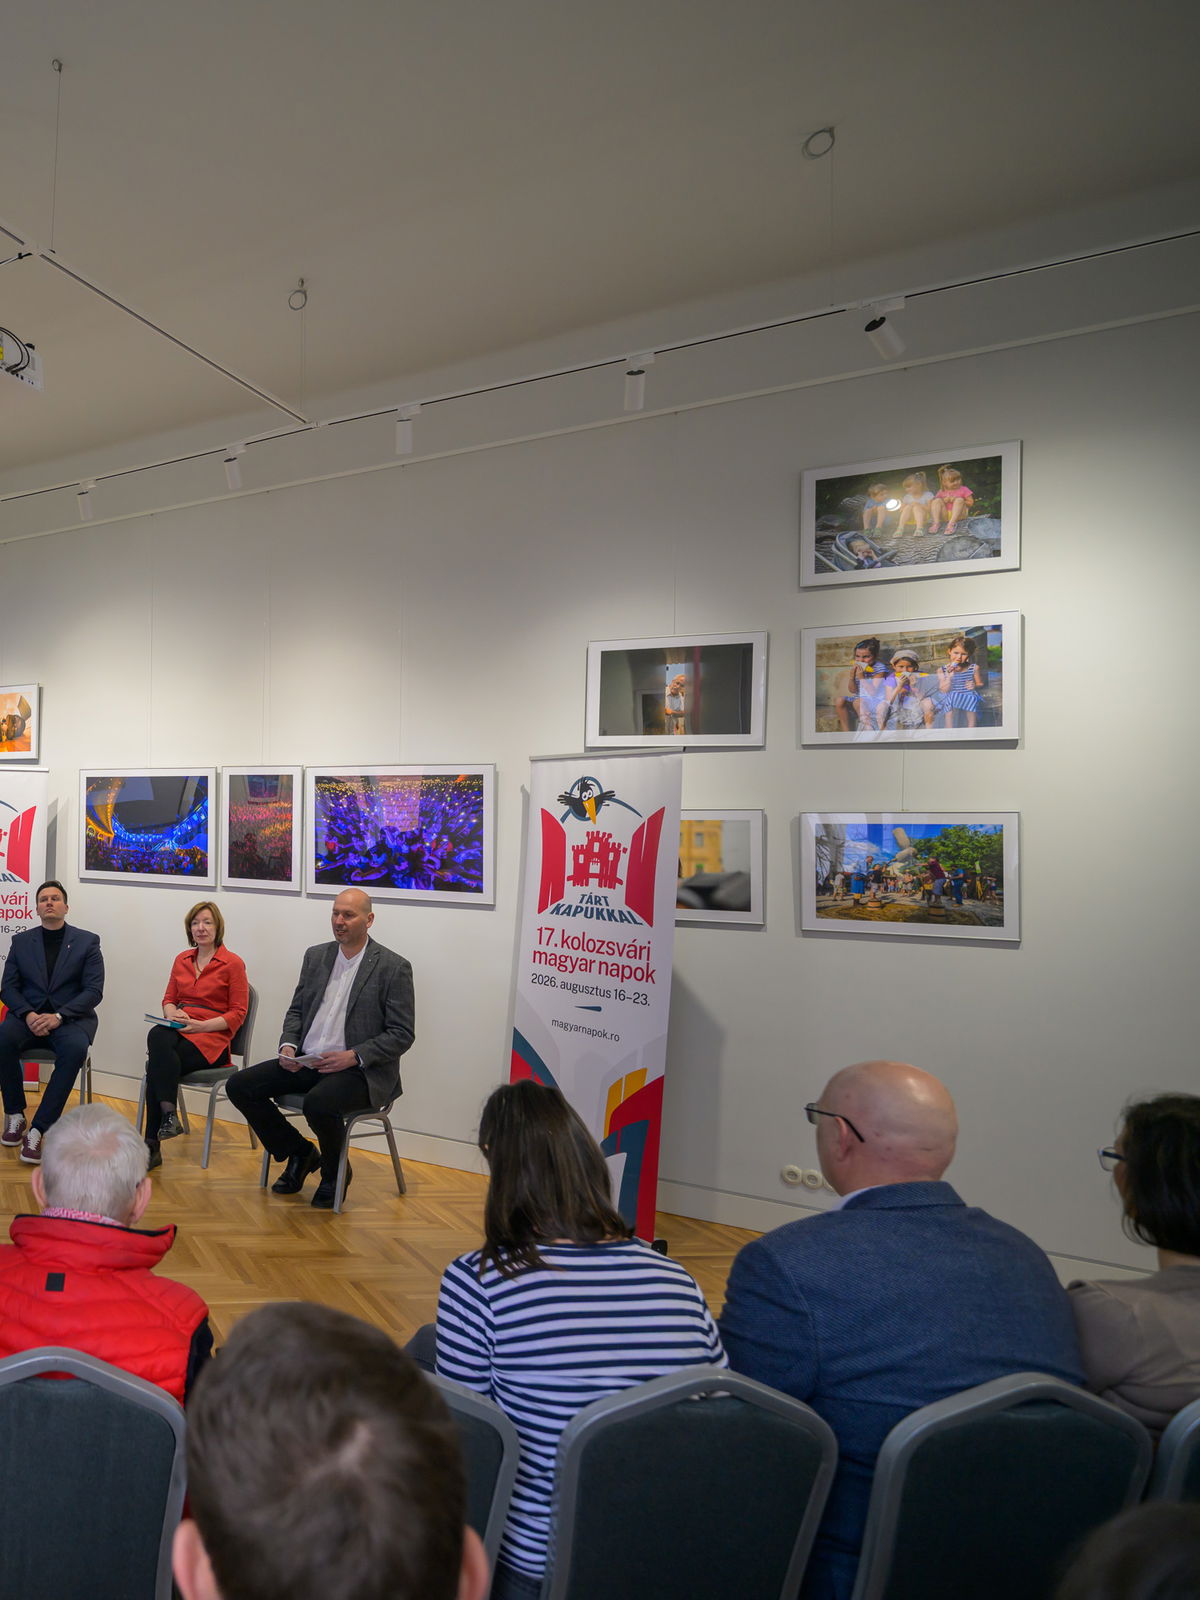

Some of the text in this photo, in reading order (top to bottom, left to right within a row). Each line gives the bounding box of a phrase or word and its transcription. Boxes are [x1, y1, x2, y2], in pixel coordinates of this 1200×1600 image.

[578, 892, 610, 907] TÁRT
[549, 903, 644, 926] KAPUKKAL
[537, 926, 651, 962] 17. kolozsvári
[532, 950, 656, 985] magyar napok
[531, 973, 559, 989] 2026.
[560, 980, 612, 999] augusztus
[551, 1018, 620, 1042] magyarnapok.ro
